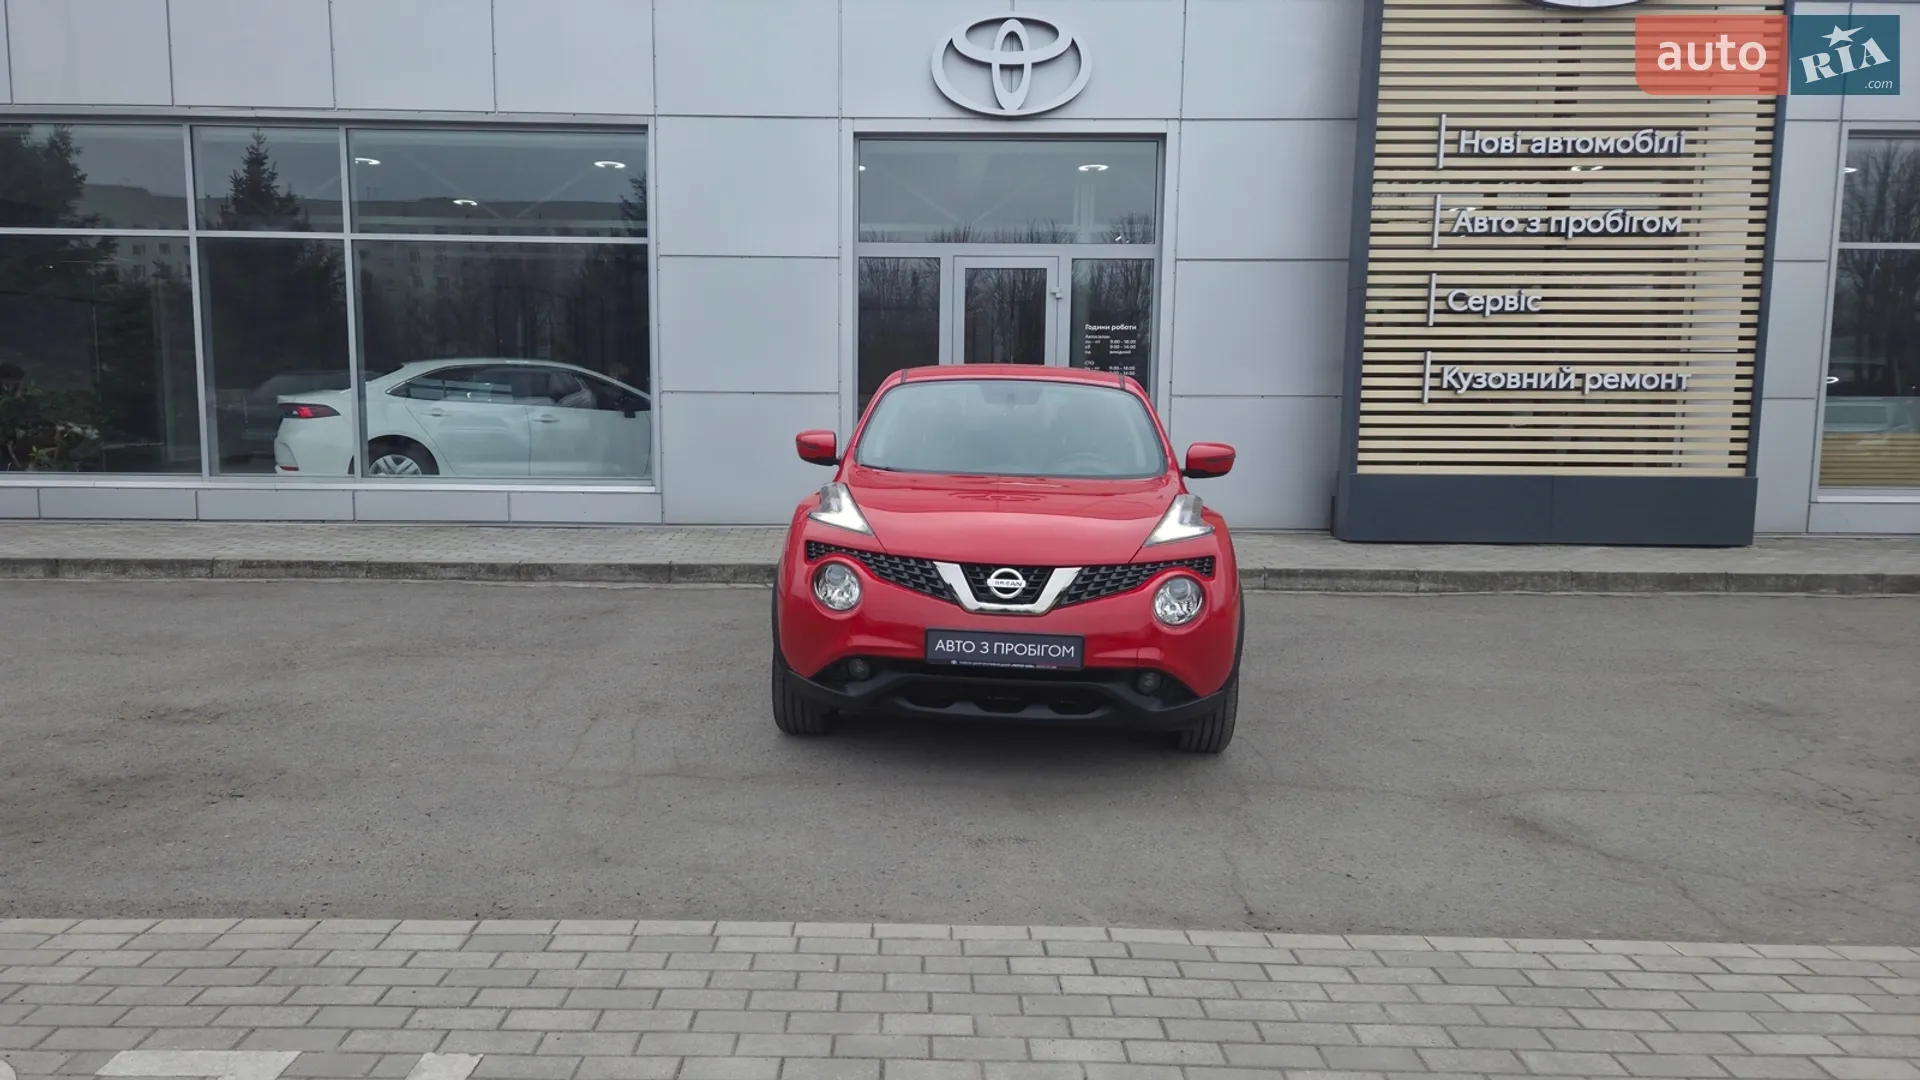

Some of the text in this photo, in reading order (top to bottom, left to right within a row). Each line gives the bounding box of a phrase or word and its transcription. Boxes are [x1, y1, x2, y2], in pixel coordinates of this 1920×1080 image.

[1458, 128, 1686, 154] Нові автомобілі
[1451, 209, 1682, 238] Авто з пробігом
[1446, 288, 1542, 317] Сервіс
[1440, 364, 1692, 394] Кузовний ремонт
[934, 638, 976, 654] АВТО
[993, 642, 1075, 659] ПРОБІГОМ
